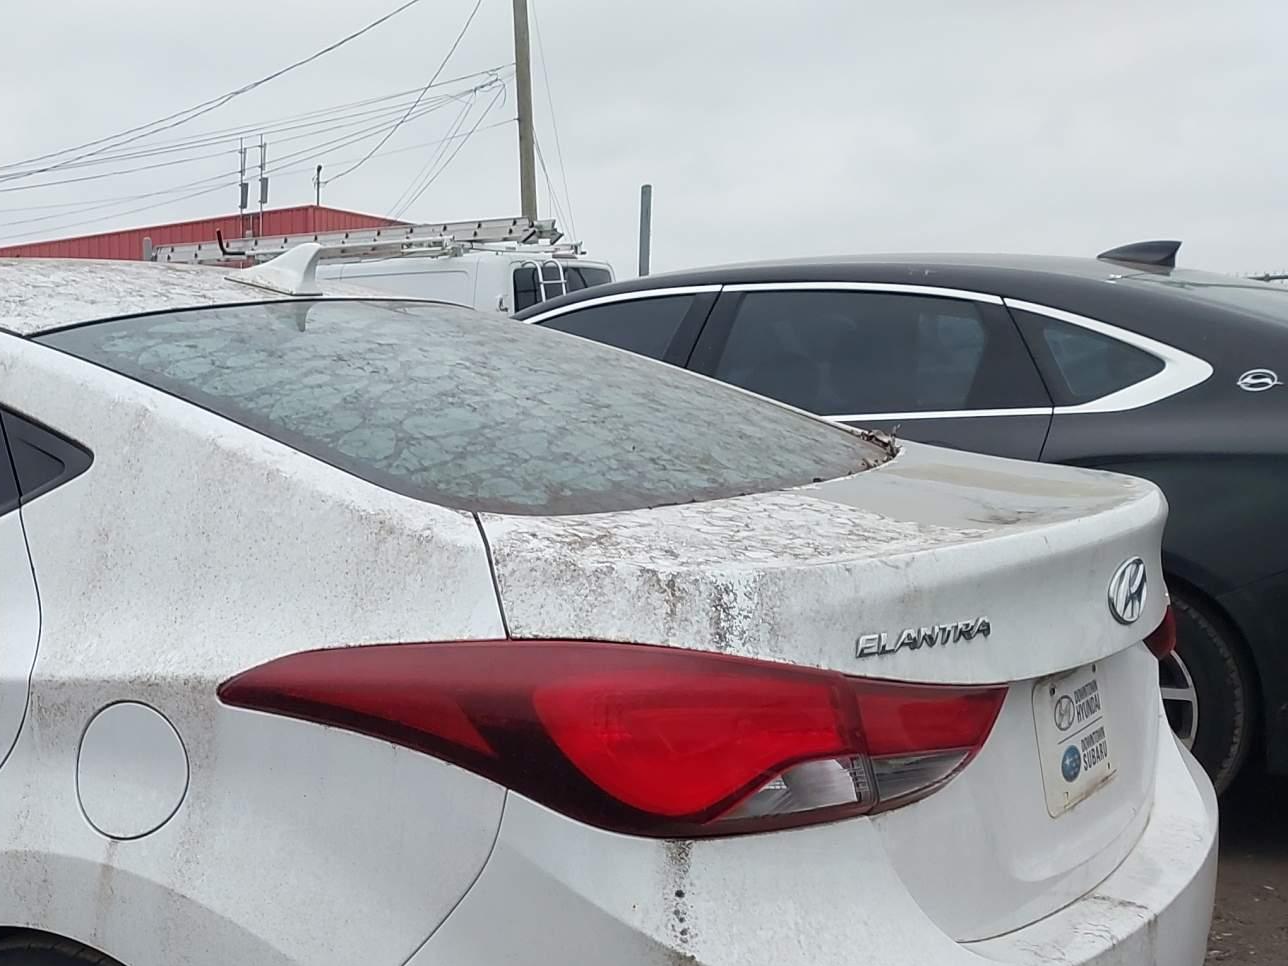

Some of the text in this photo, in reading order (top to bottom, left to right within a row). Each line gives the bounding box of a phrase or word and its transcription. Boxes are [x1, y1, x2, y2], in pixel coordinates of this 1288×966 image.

[855, 616, 992, 659] ELANTRA
[1074, 680, 1098, 704] DOWNTOWN
[1076, 693, 1101, 723] HYUNDAI
[1081, 727, 1105, 752] DOWNTOWN
[1083, 740, 1107, 771] SUBARU
